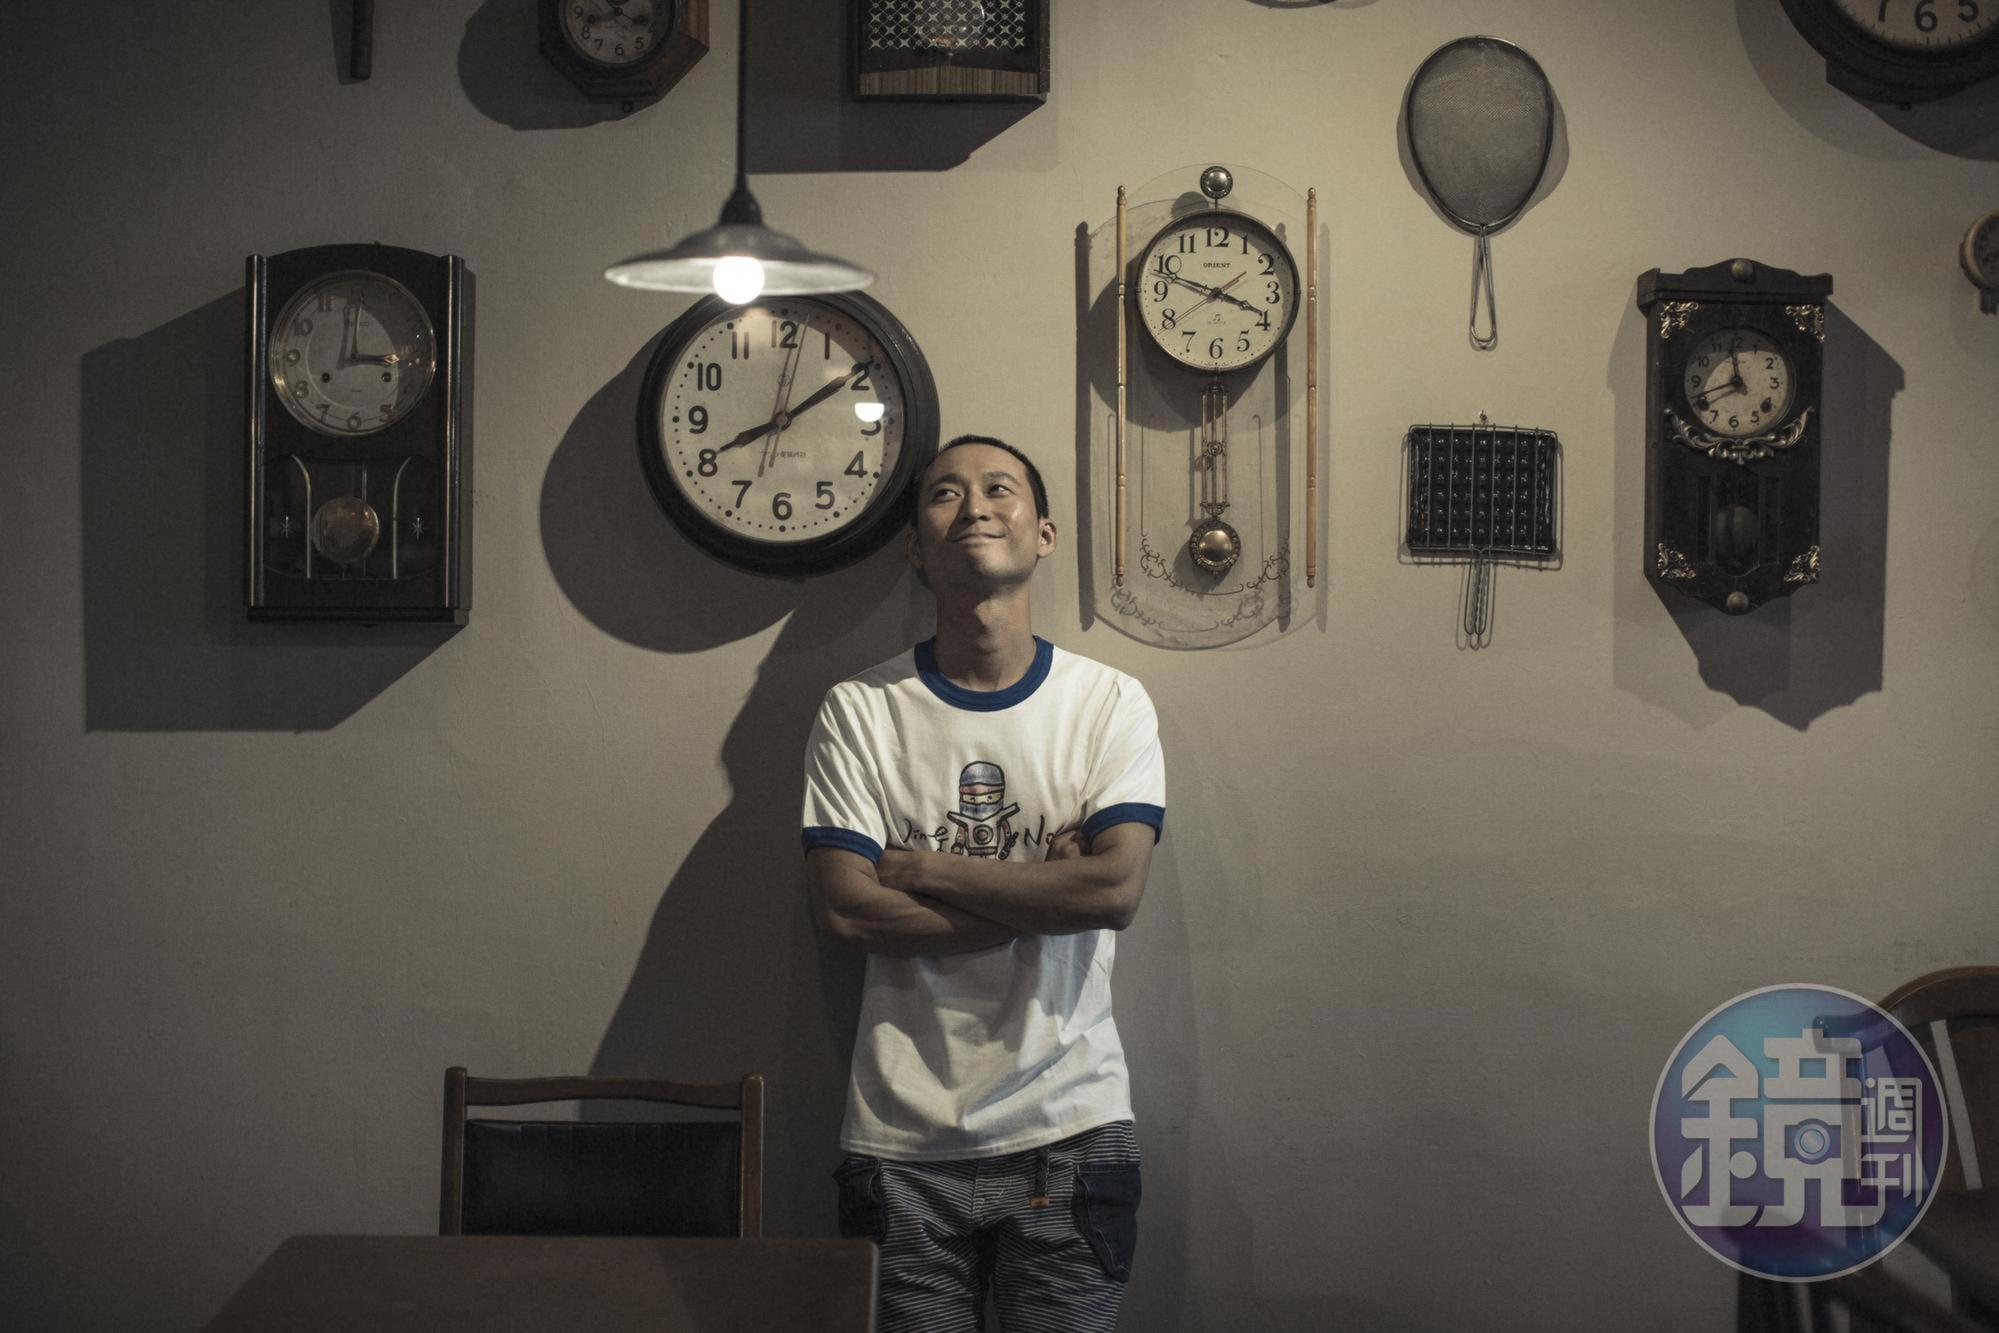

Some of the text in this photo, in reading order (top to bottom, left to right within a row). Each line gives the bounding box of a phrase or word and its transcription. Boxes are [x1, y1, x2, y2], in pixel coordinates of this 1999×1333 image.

[1914, 0, 1938, 32] 6
[581, 25, 591, 40] 8
[634, 37, 644, 50] 5
[594, 38, 604, 51] 7
[614, 43, 625, 56] 6
[1179, 233, 1197, 254] 11
[1205, 226, 1230, 248] 12
[1241, 234, 1249, 255] 1
[1156, 254, 1182, 275] 10
[1257, 253, 1275, 275] 2
[1153, 281, 1169, 303] 9
[1265, 281, 1280, 304] 3
[1161, 308, 1176, 330] 8
[1255, 309, 1271, 331] 4
[731, 331, 750, 360] 11
[771, 320, 798, 349] 12
[1181, 331, 1197, 353] 7
[1236, 329, 1250, 352] 5
[824, 332, 830, 360] 1
[1208, 337, 1224, 359] 6
[1697, 355, 1710, 368] 10
[1765, 357, 1774, 370] 2
[697, 362, 722, 391] 10
[851, 362, 870, 391] 2
[1691, 375, 1701, 388] 9
[1769, 377, 1780, 390] 3
[316, 404, 331, 424] 7
[346, 412, 362, 430] 6
[687, 405, 709, 434] 9
[1710, 409, 1719, 423] 7
[1728, 415, 1739, 428] 6
[1750, 411, 1760, 424] 5
[697, 449, 718, 477] 8
[843, 450, 869, 479] 4
[731, 480, 752, 509] 7
[814, 481, 836, 510] 5
[771, 492, 793, 521] 6
